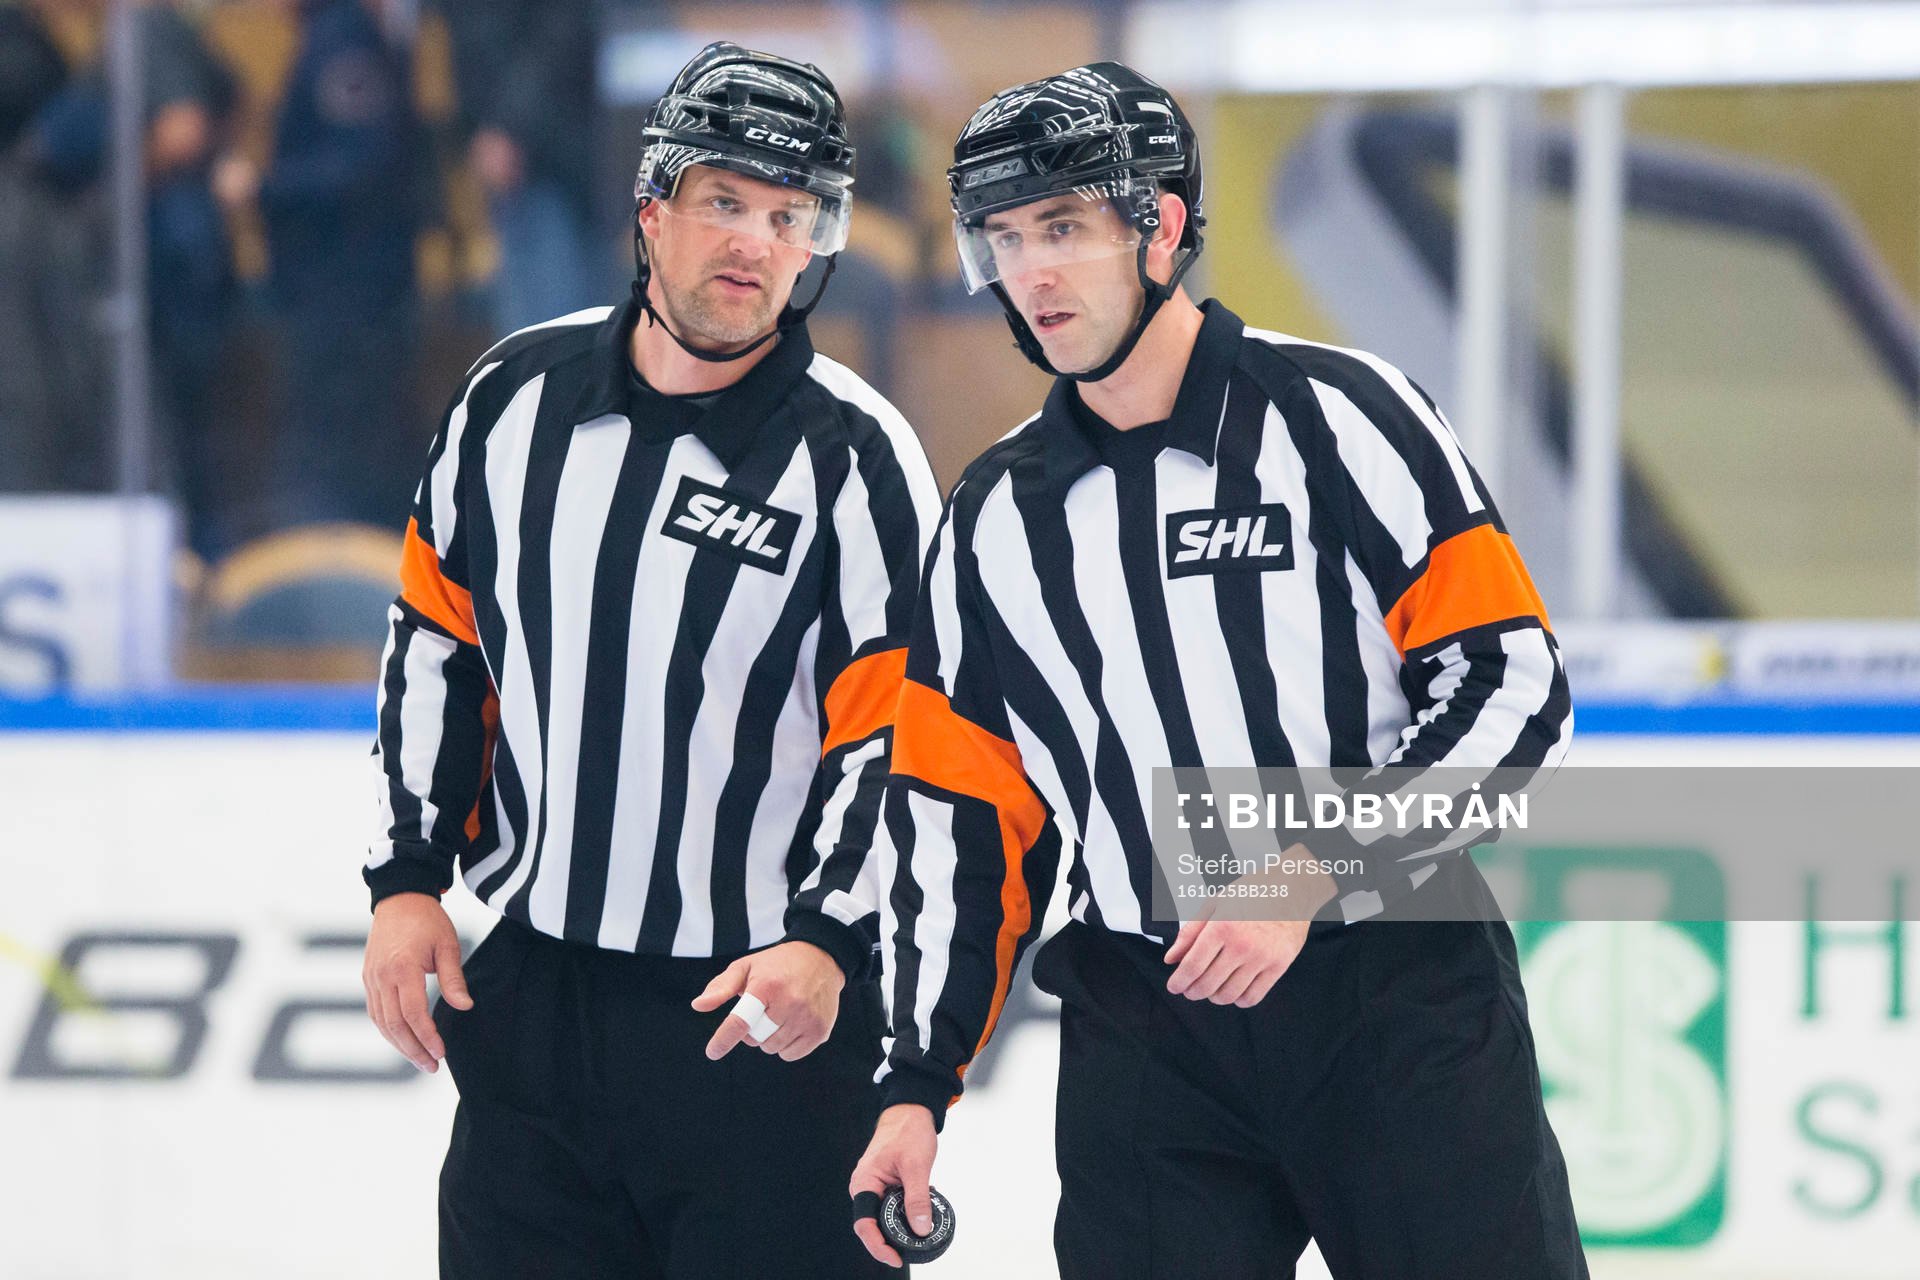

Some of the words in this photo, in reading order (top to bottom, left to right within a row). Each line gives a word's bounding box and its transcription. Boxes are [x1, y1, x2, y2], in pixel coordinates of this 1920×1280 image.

[745, 127, 811, 152] CCM
[1149, 135, 1176, 144] CCM
[965, 160, 1020, 187] CCM
[674, 494, 783, 559] SHL
[1174, 515, 1284, 564] SHL
